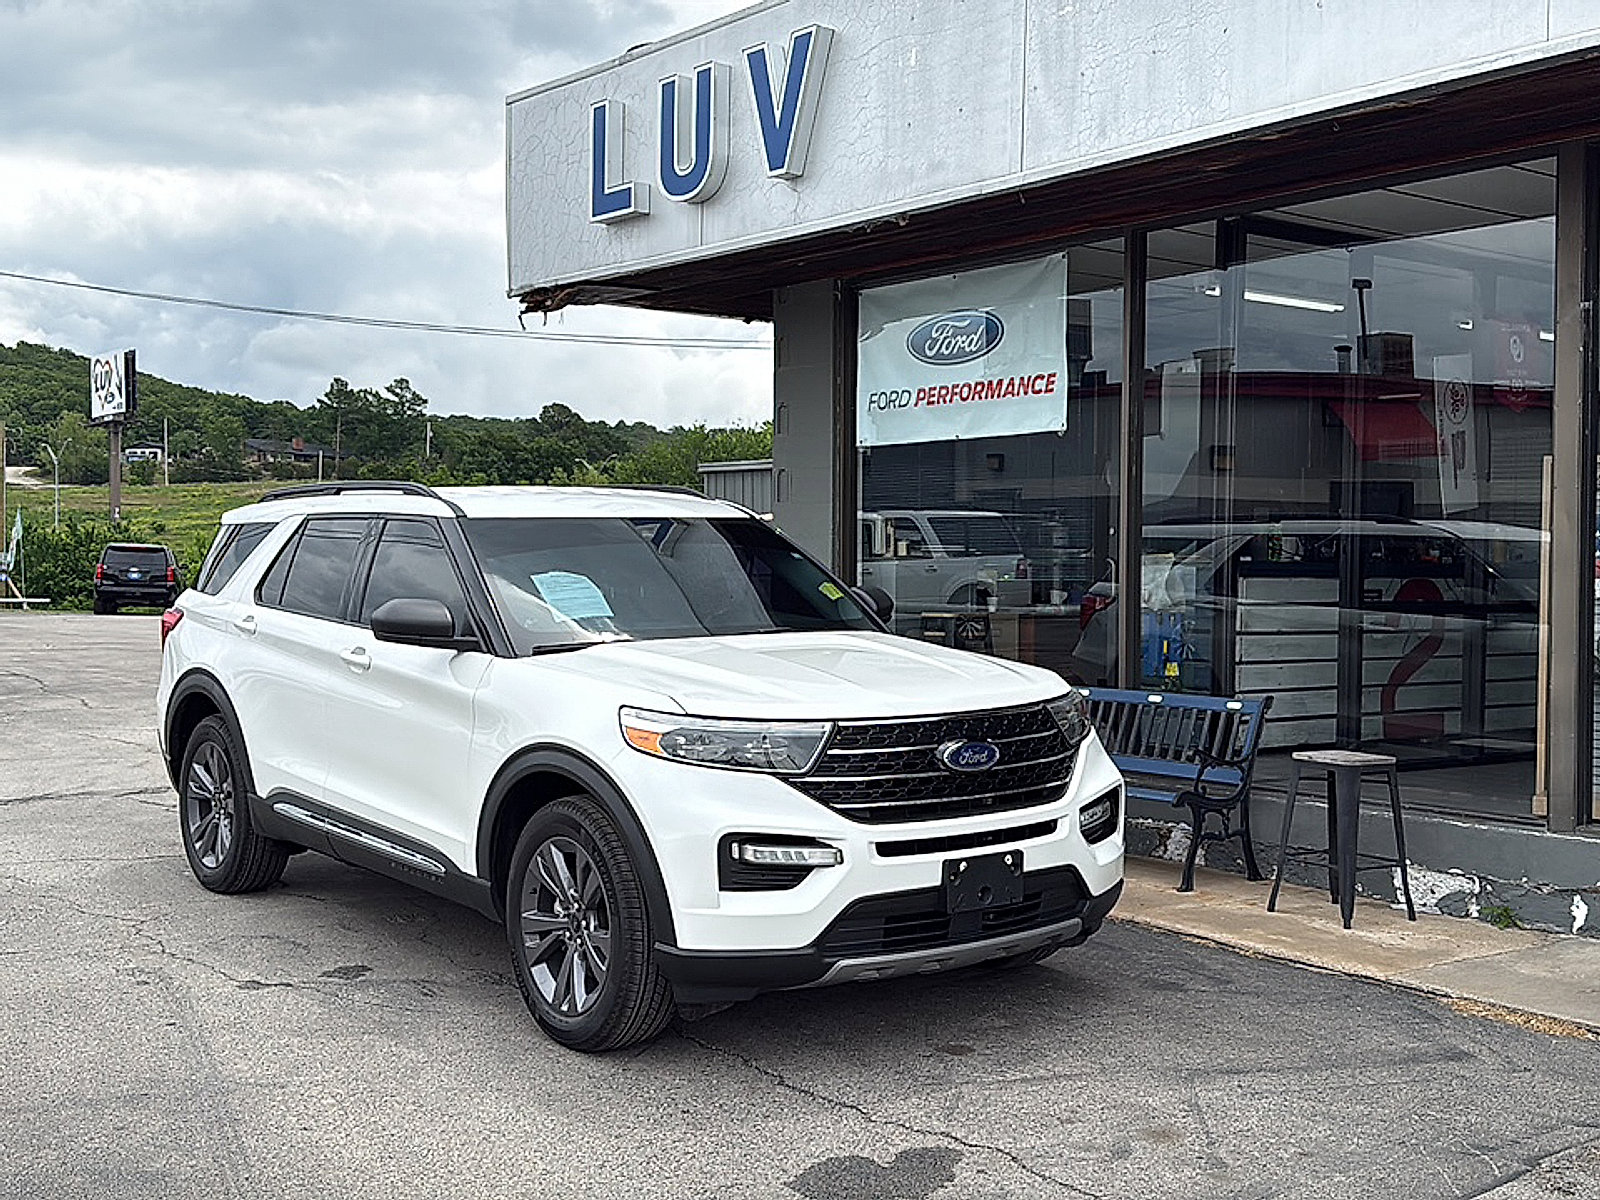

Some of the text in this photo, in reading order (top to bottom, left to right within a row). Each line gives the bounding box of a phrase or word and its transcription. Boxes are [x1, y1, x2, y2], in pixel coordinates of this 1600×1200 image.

[590, 24, 833, 223] LUV
[924, 319, 983, 358] Ford
[868, 372, 1058, 412] FORD PERFORMANCE
[958, 746, 988, 765] Ford
